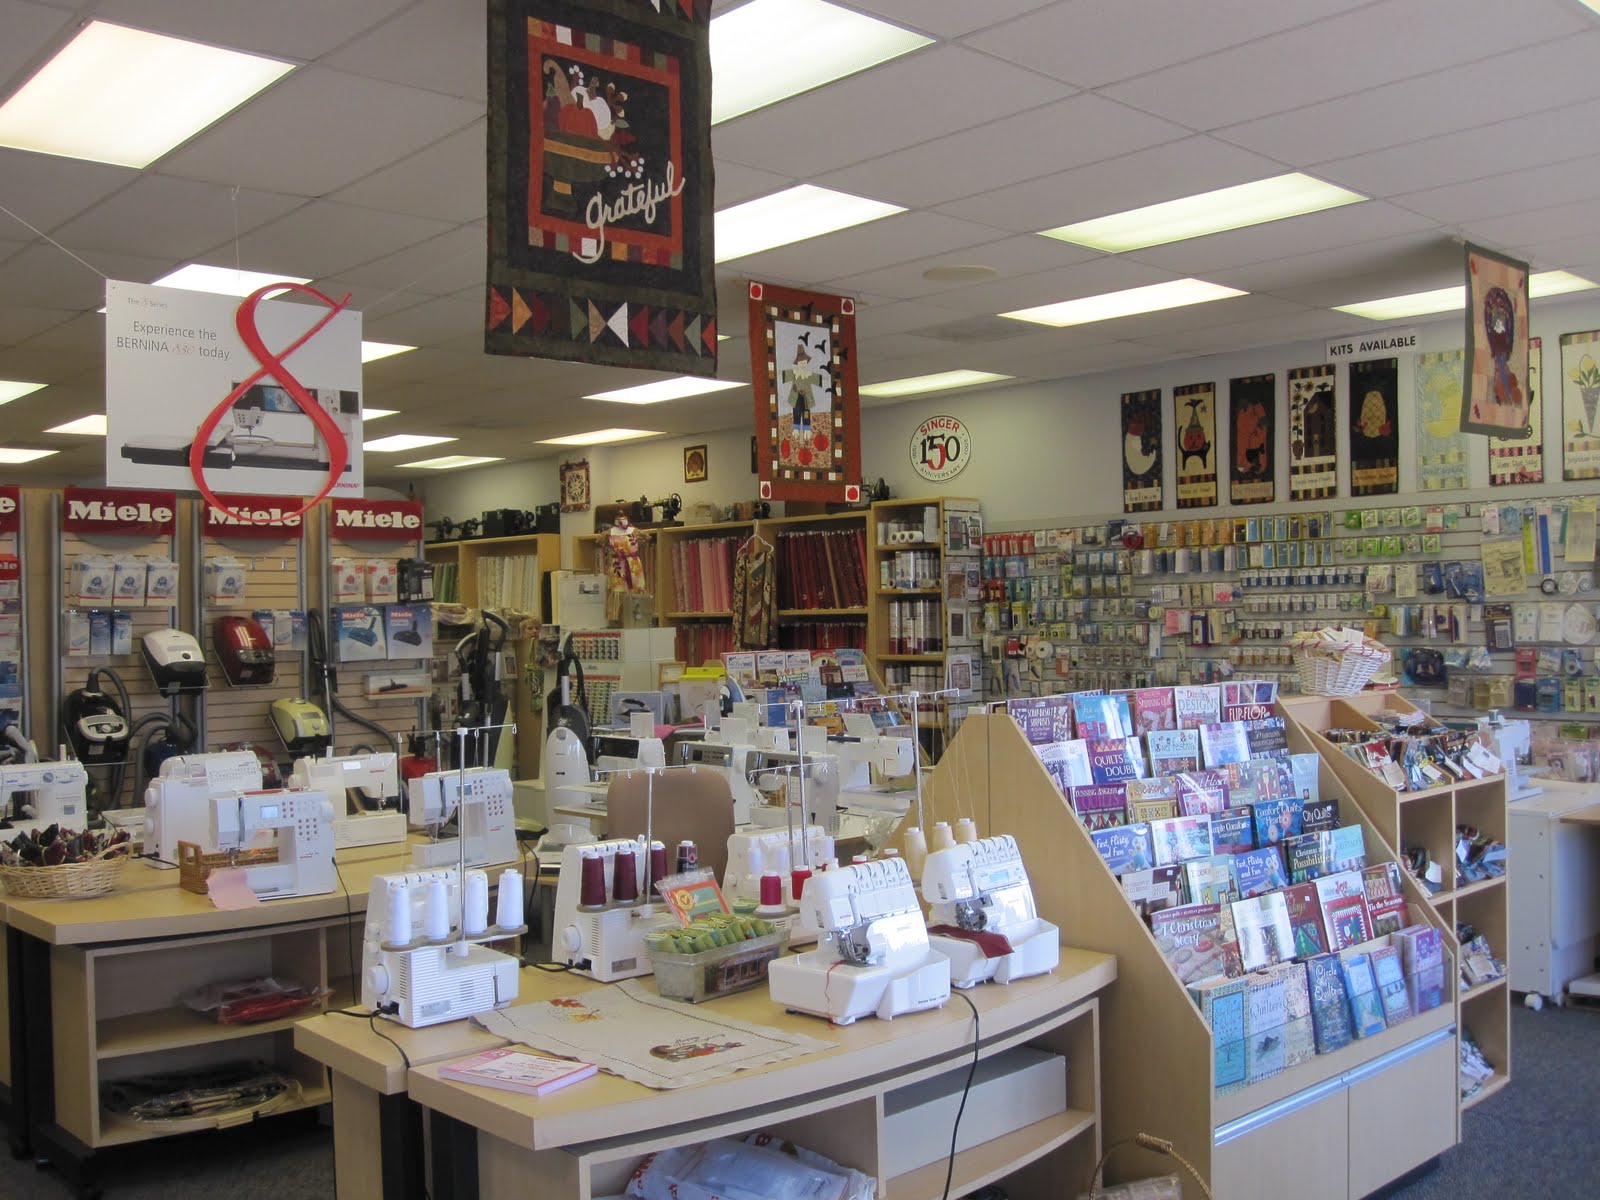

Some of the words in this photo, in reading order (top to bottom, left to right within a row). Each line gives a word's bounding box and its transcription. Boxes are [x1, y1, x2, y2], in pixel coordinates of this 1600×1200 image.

[573, 161, 686, 263] grateful
[133, 320, 195, 338] Experience
[198, 328, 217, 341] the
[116, 336, 169, 352] BERNINA
[1330, 343, 1353, 356] KITS
[1359, 335, 1416, 353] AVAILABLE
[920, 418, 960, 436] SINGER
[920, 433, 961, 471] 150
[920, 465, 961, 478] ANNIVERSARY
[69, 500, 173, 522] Miele
[208, 507, 302, 526] Miele
[336, 510, 420, 528] Miele
[0, 562, 17, 570] ele
[1178, 697, 1219, 711] DESIGNS
[1094, 754, 1124, 767] QUILTS
[1075, 789, 1096, 797] TUNNING
[1255, 803, 1280, 819] Comfort
[1302, 811, 1314, 823] City
[1266, 815, 1282, 827] Heart
[1112, 846, 1124, 857] Fun
[1295, 848, 1318, 858] Christmas
[1293, 854, 1331, 870] Possibilite
[1241, 867, 1250, 878] and
[1251, 866, 1261, 876] Fun
[1376, 901, 1384, 909] the
[1384, 897, 1402, 907] Season
[1170, 917, 1218, 934] Christmas
[1174, 932, 1200, 948] Story
[1315, 962, 1337, 981] Circle
[1314, 982, 1343, 1002] Quilters
